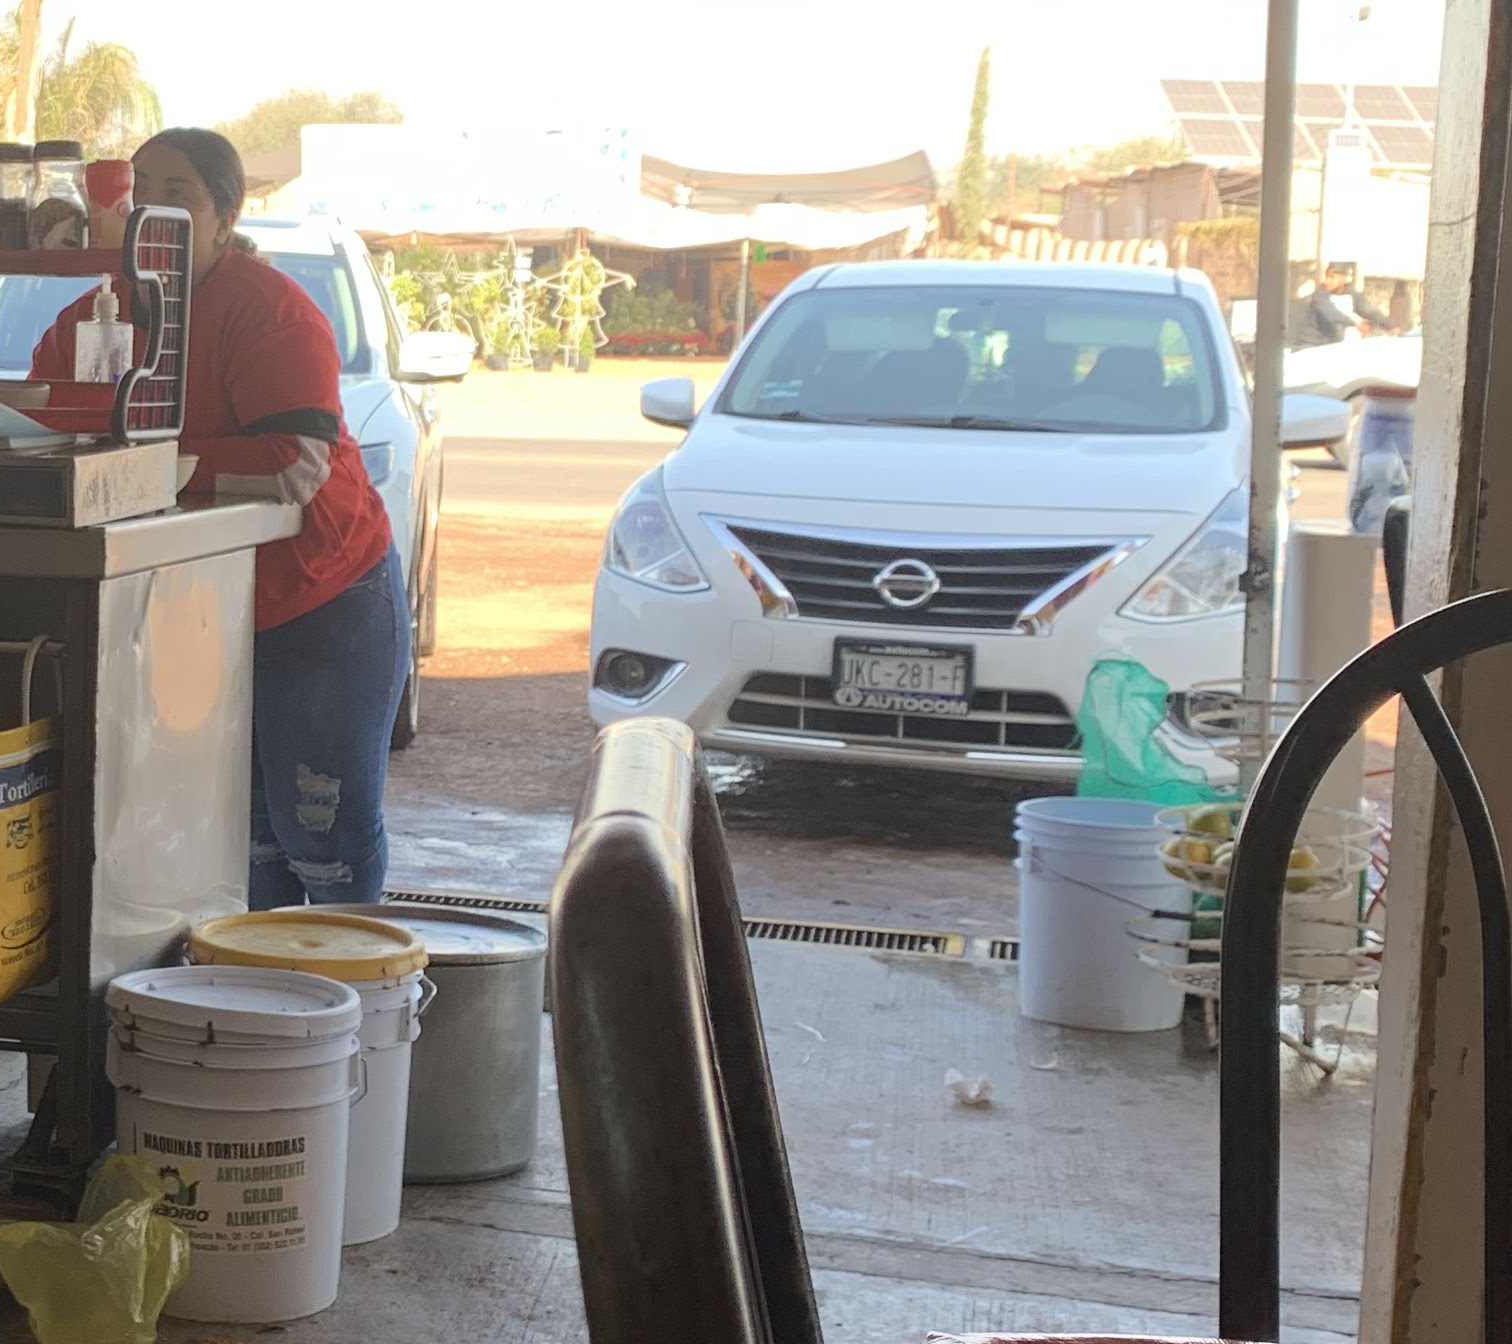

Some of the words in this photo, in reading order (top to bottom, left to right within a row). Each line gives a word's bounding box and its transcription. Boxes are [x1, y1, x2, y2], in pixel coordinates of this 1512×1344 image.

[864, 692, 968, 715] AUTOCOM
[143, 1132, 202, 1158] MAQUINAS
[207, 1136, 306, 1159] TORTILLADORAS
[216, 1161, 306, 1183] ANTIADHERENTE
[243, 1186, 284, 1205] GRADO
